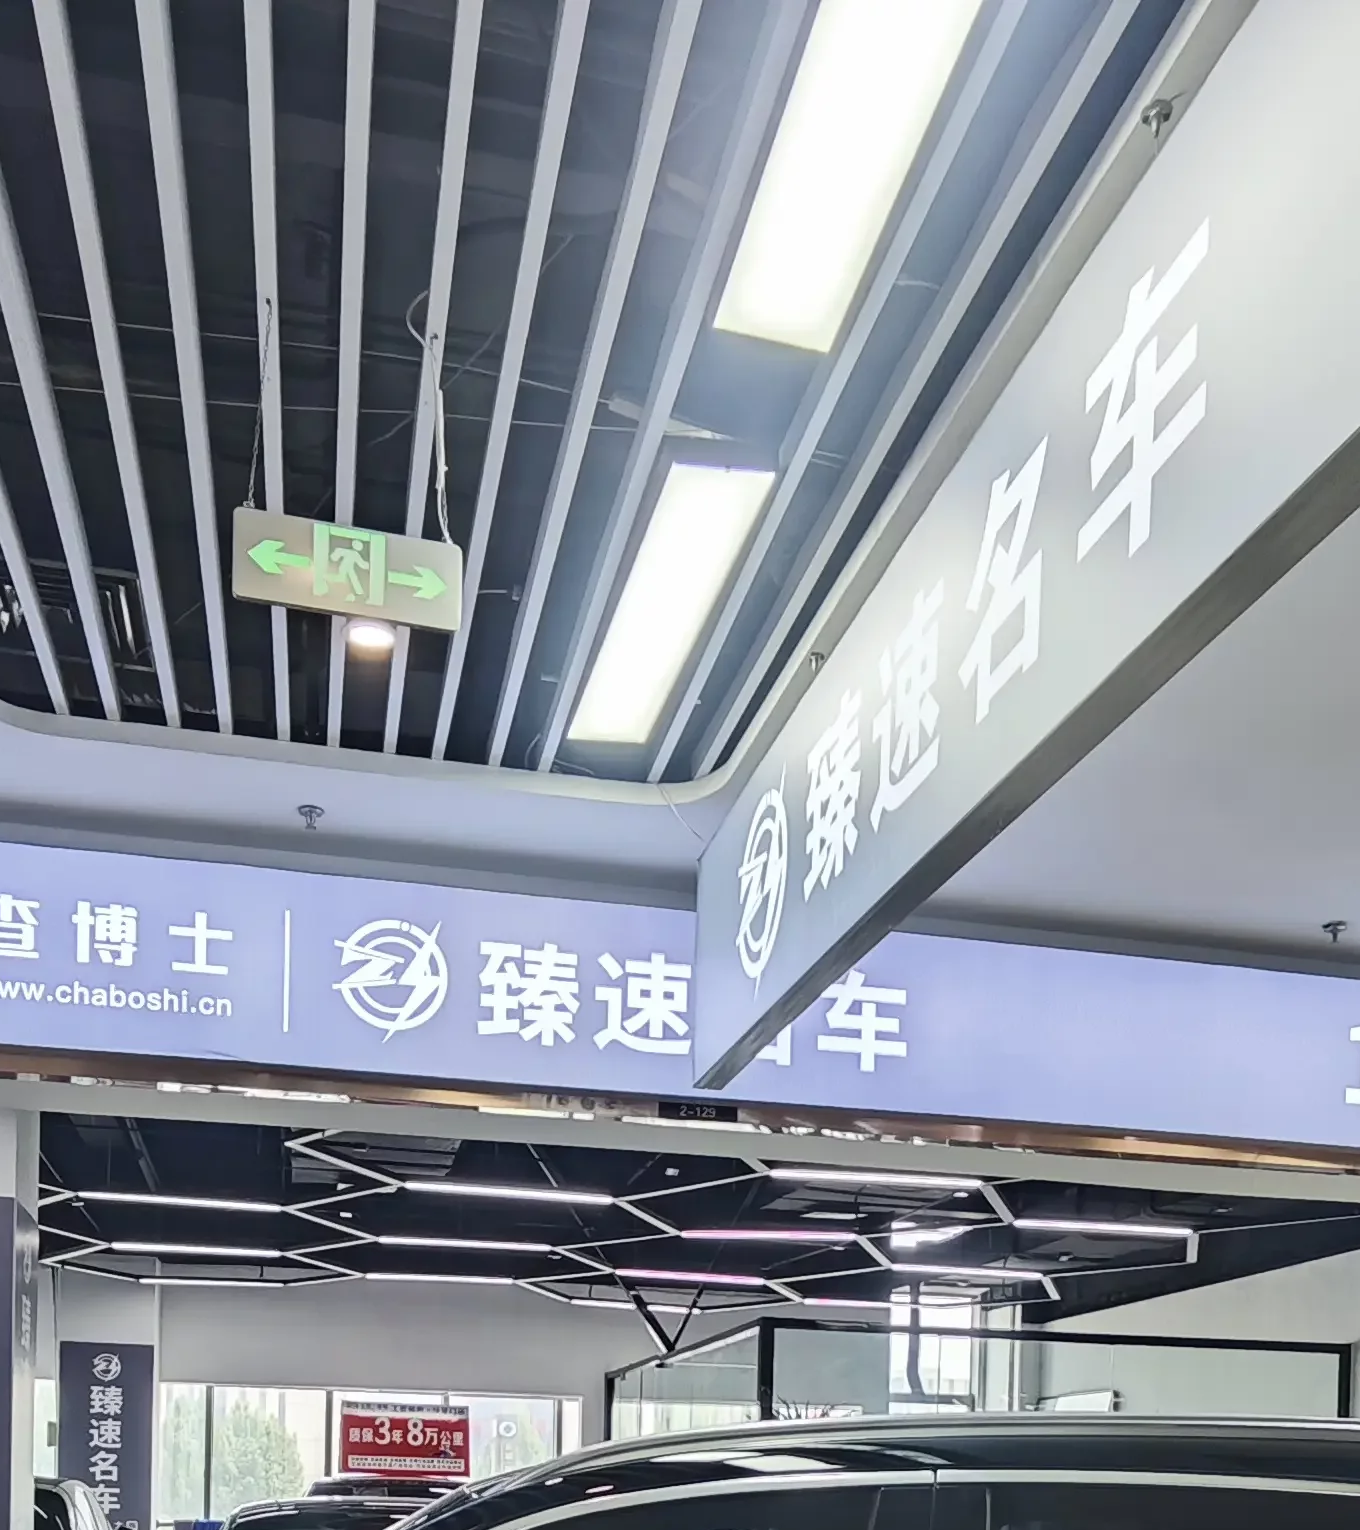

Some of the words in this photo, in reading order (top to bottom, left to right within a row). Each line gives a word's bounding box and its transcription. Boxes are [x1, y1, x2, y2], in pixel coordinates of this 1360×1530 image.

[802, 217, 1211, 902] 臻速名车
[476, 940, 908, 1073] 臻速车
[679, 1105, 717, 1118] 2-129
[88, 1385, 124, 1515] 臻速名车
